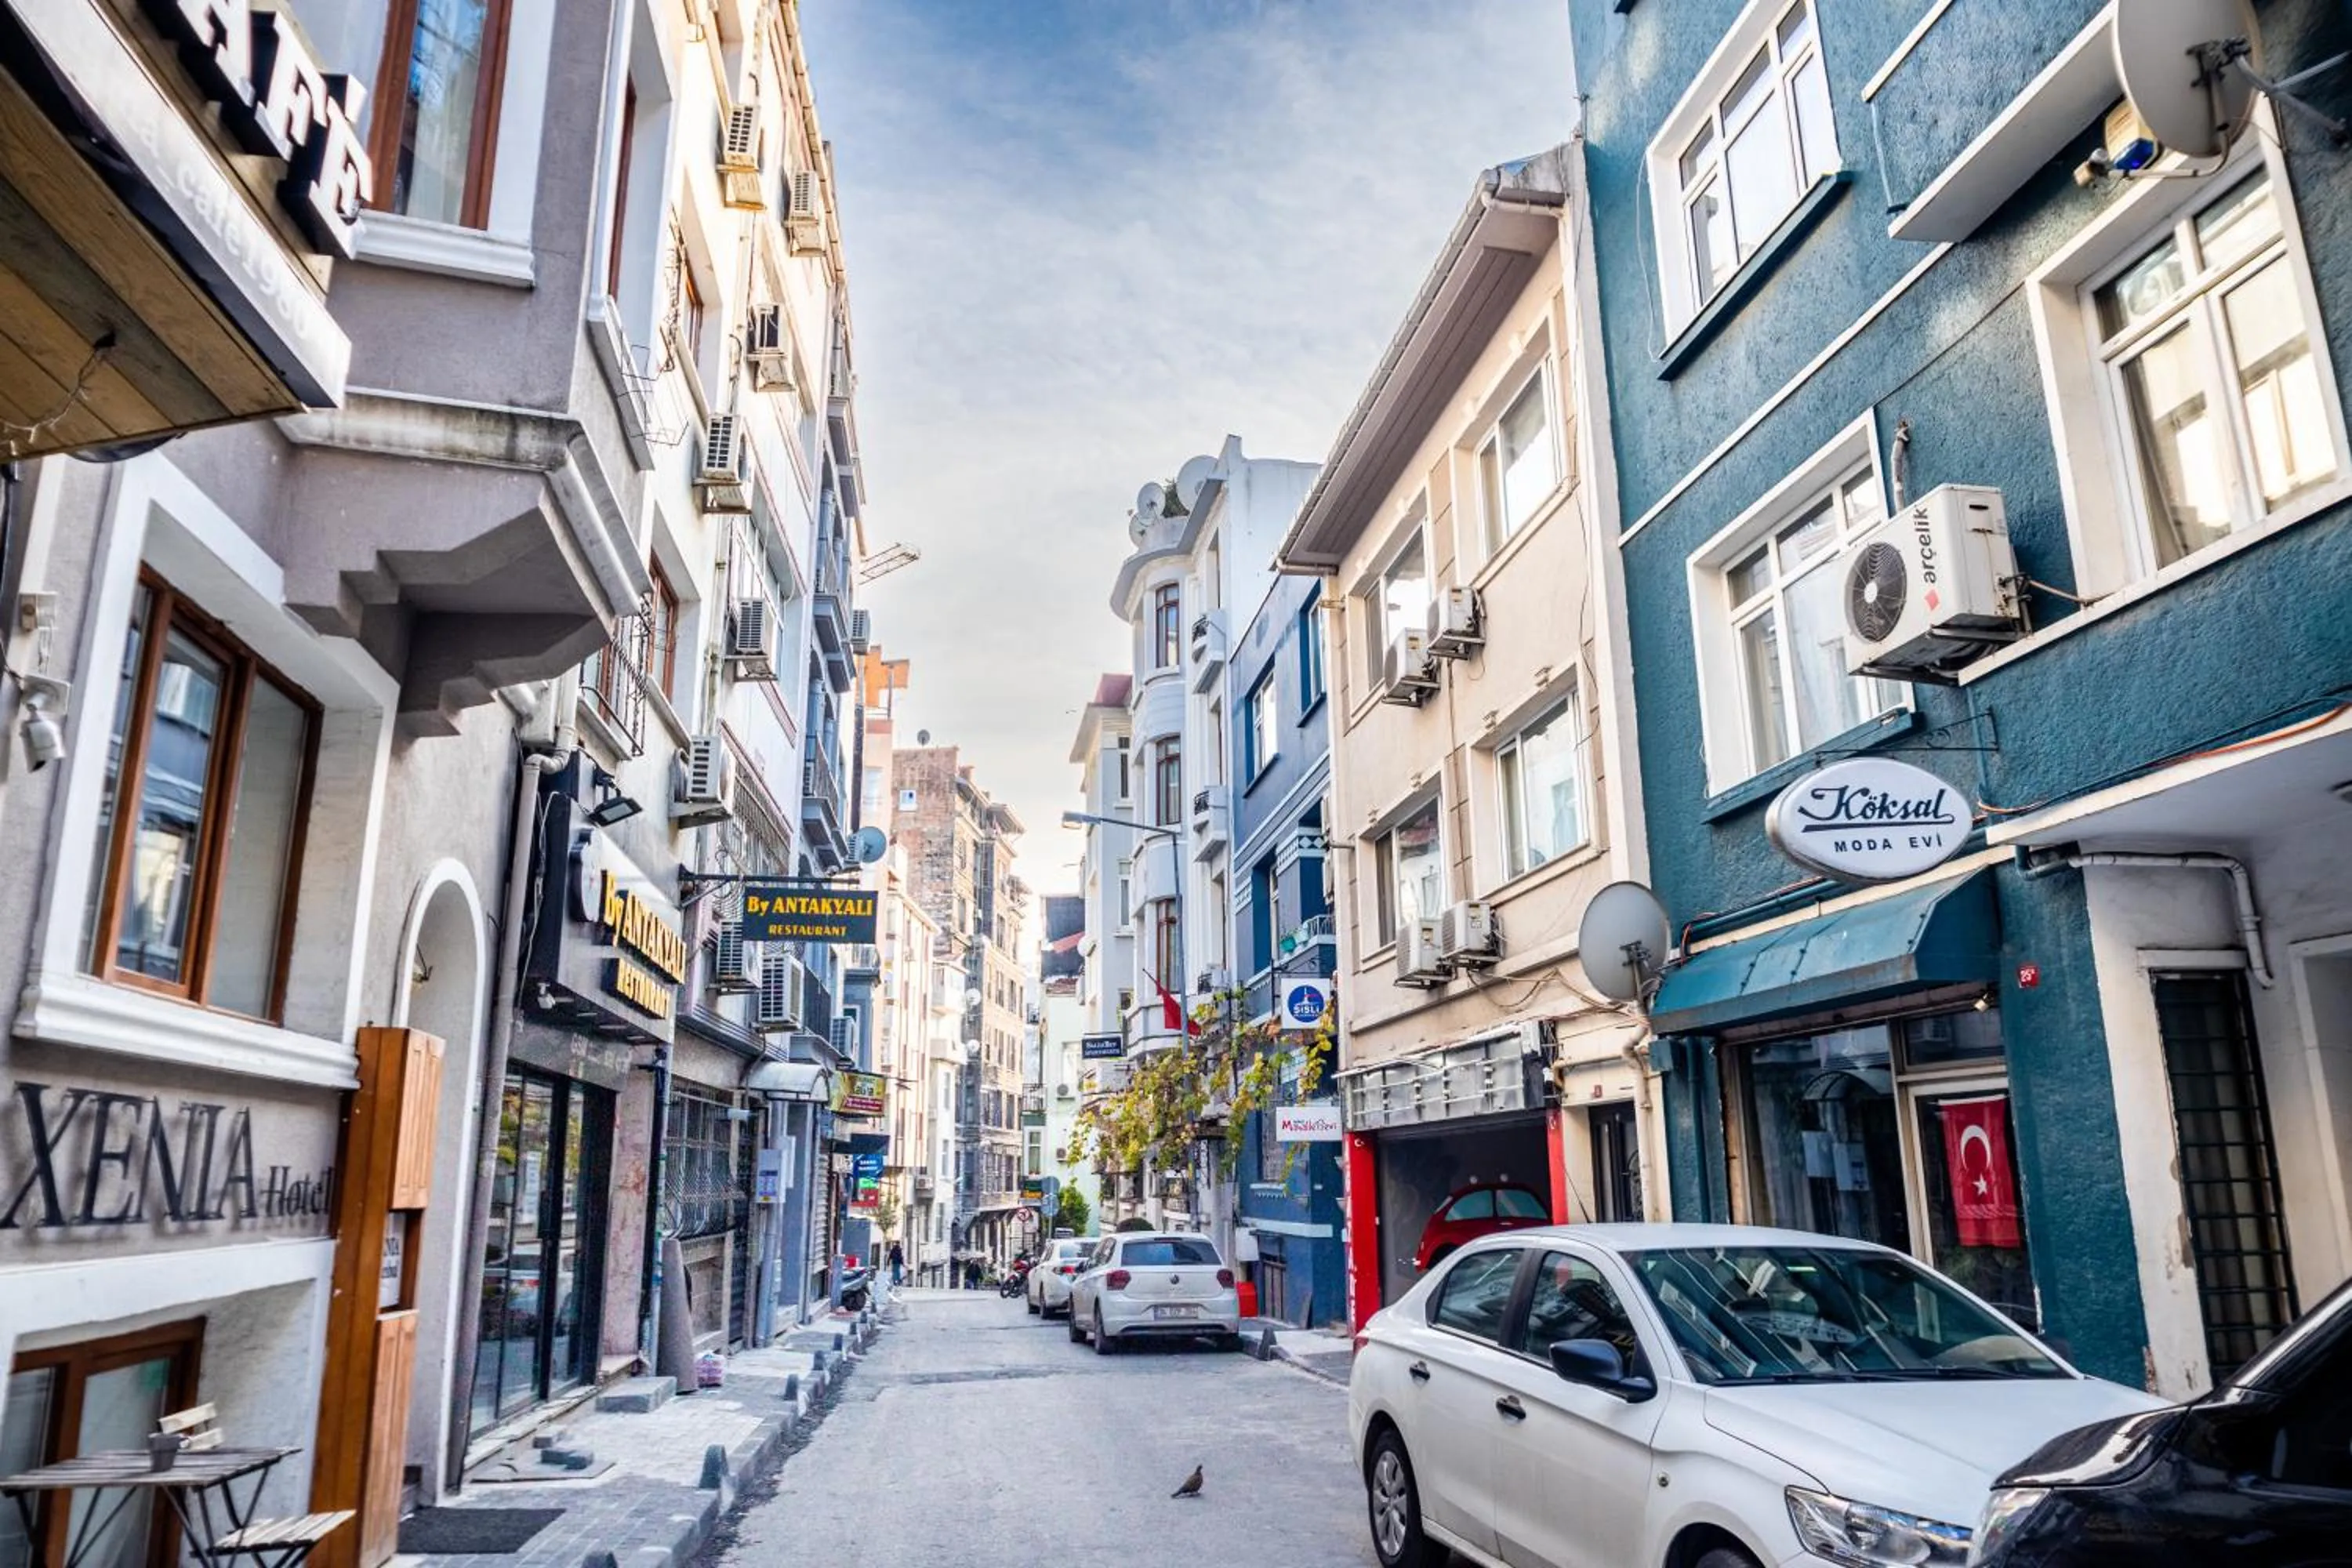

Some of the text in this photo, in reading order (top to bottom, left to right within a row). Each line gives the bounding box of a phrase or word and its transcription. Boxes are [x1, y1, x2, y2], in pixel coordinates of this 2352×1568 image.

[1913, 507, 1937, 584] arçelik
[1798, 785, 1955, 824] Köksal
[1834, 838, 1893, 852] MODA
[747, 895, 873, 916] By ANTAKYALI
[604, 871, 687, 985] By ANTAKYALI
[768, 924, 847, 936] RESTAURANT
[0, 1080, 336, 1229] XENIA Hotel
